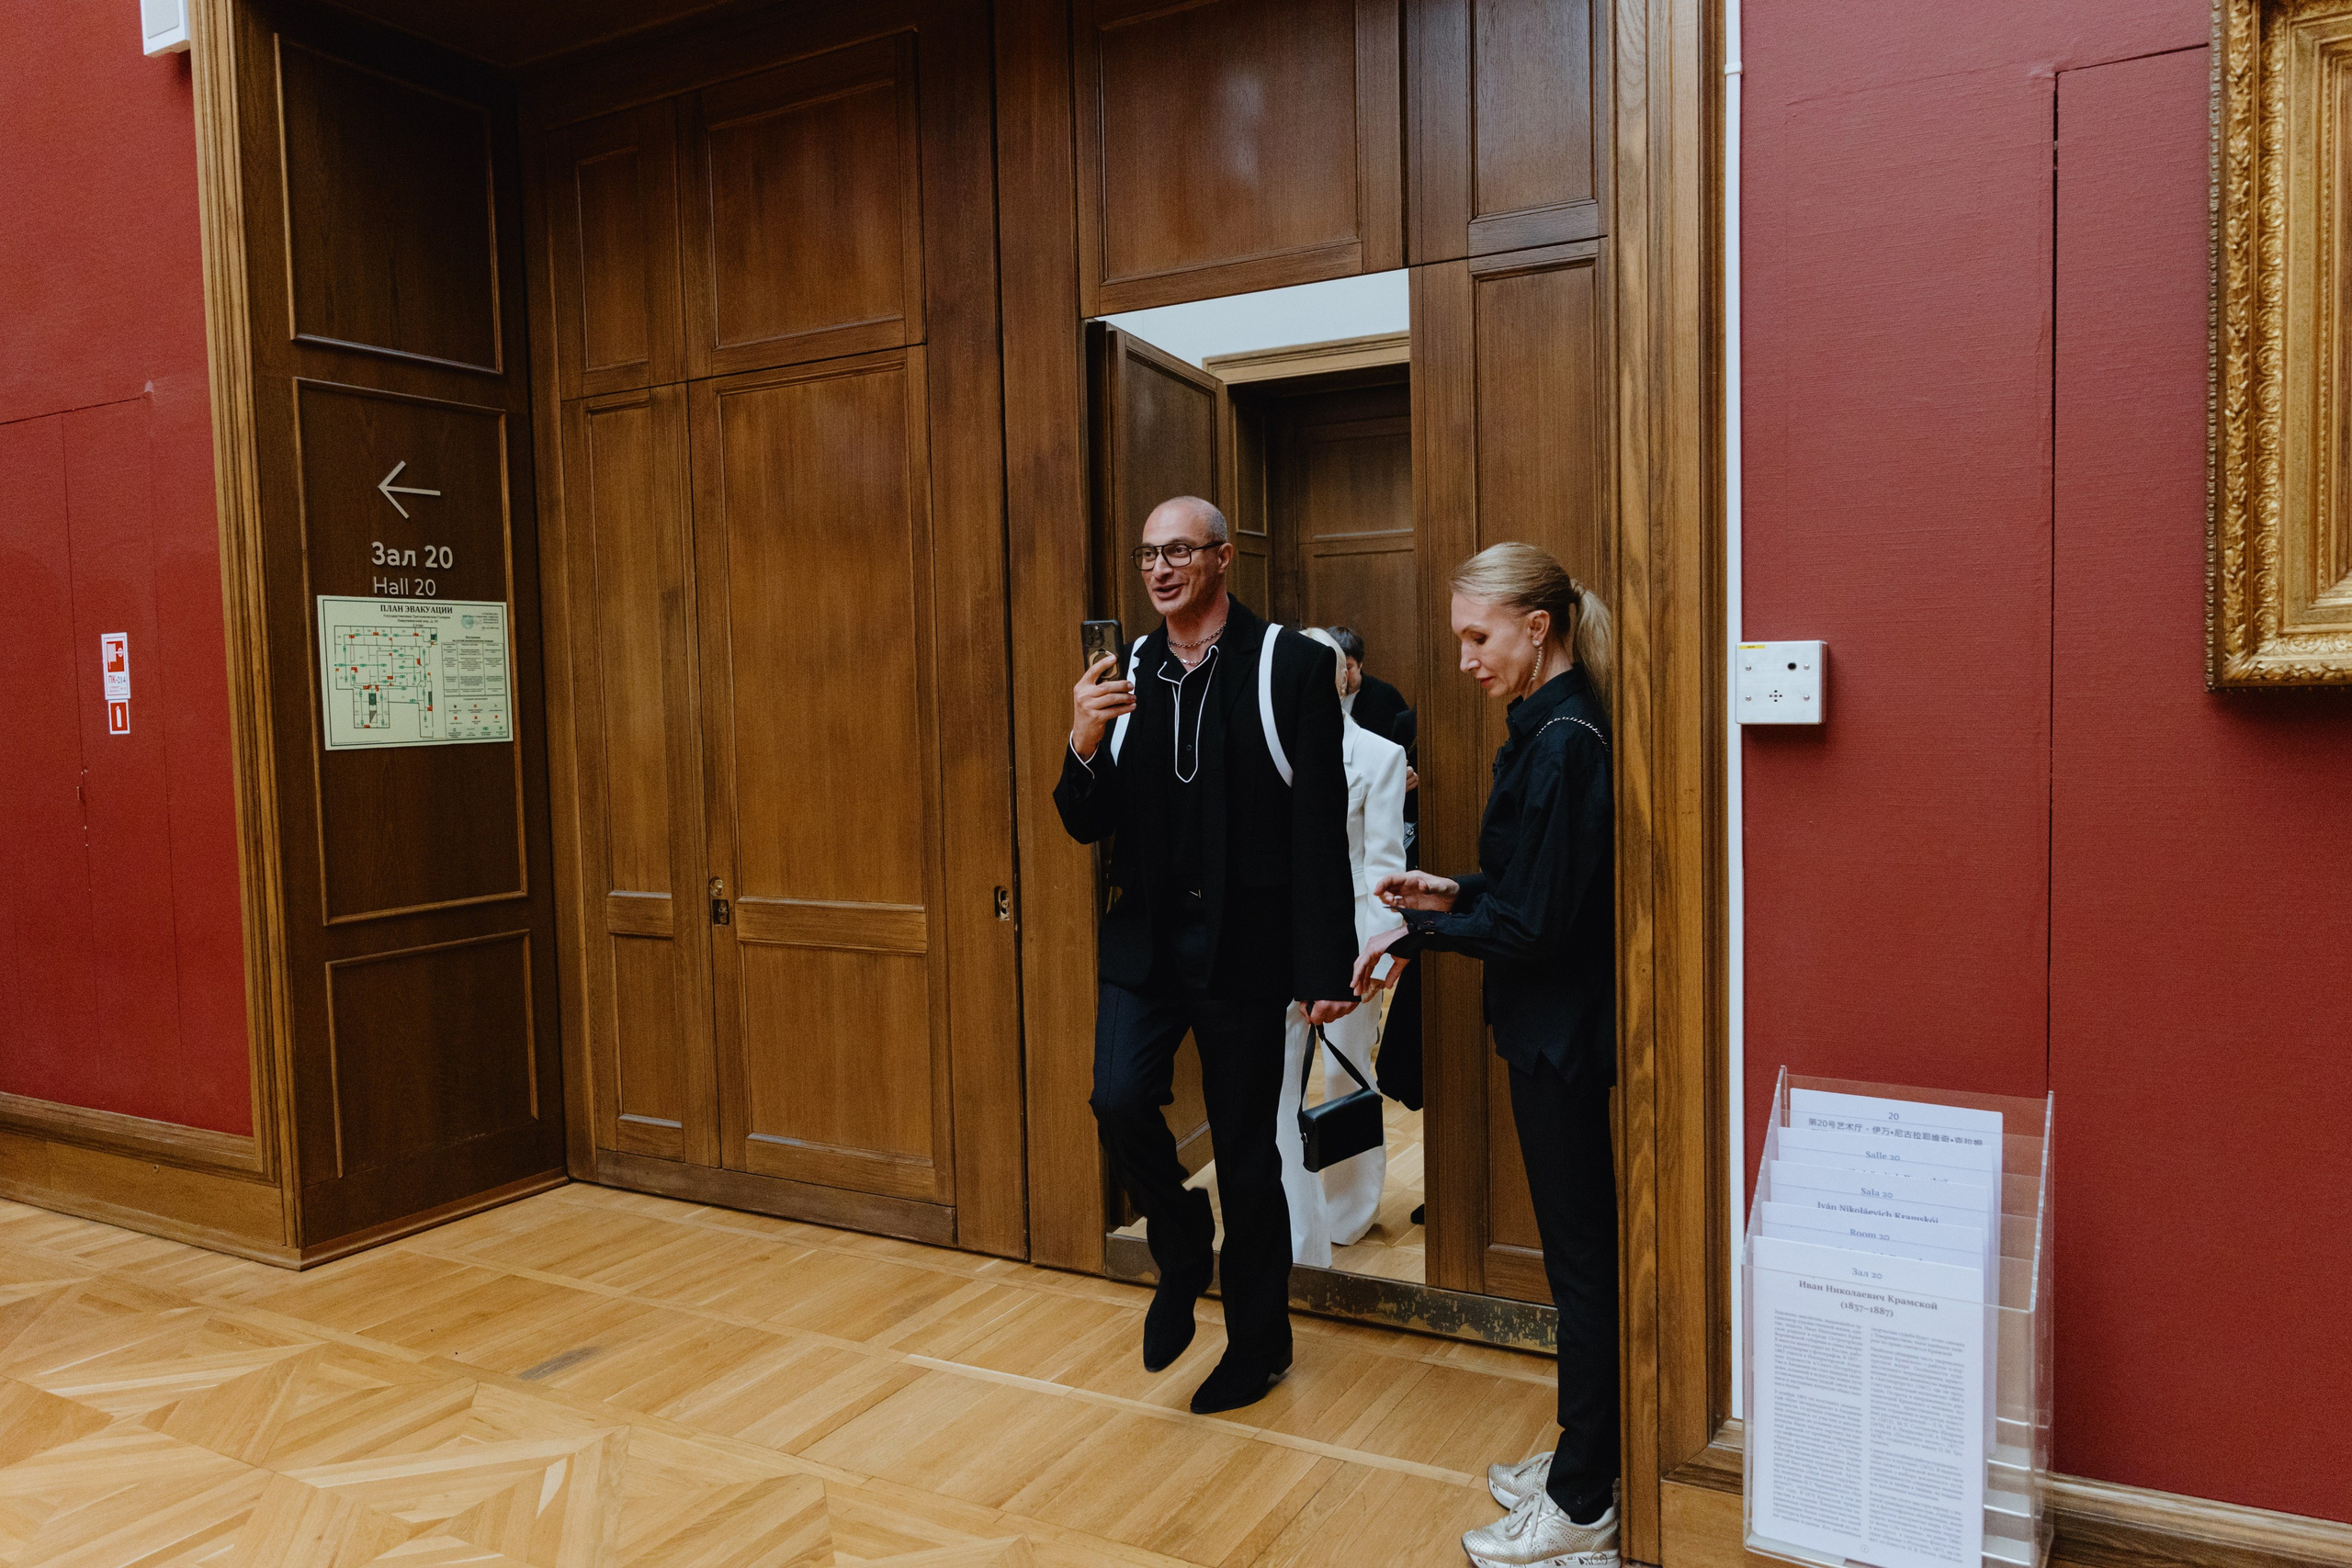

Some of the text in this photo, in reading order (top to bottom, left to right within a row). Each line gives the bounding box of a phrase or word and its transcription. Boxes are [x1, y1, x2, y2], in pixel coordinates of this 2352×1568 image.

[371, 541, 453, 569] Зал 20
[373, 576, 436, 596] Hall 20
[380, 604, 453, 615] ПЛАН ЭВАКУАЦИИ
[1888, 1111, 1899, 1121] 20
[1865, 1151, 1887, 1159] Salle
[1860, 1188, 1880, 1196] Sala
[1817, 1201, 1837, 1211] Iván
[1849, 1228, 1876, 1239] Room
[1851, 1267, 1869, 1278] Зал
[1799, 1280, 1939, 1311] Иван Николаевич Крамской
